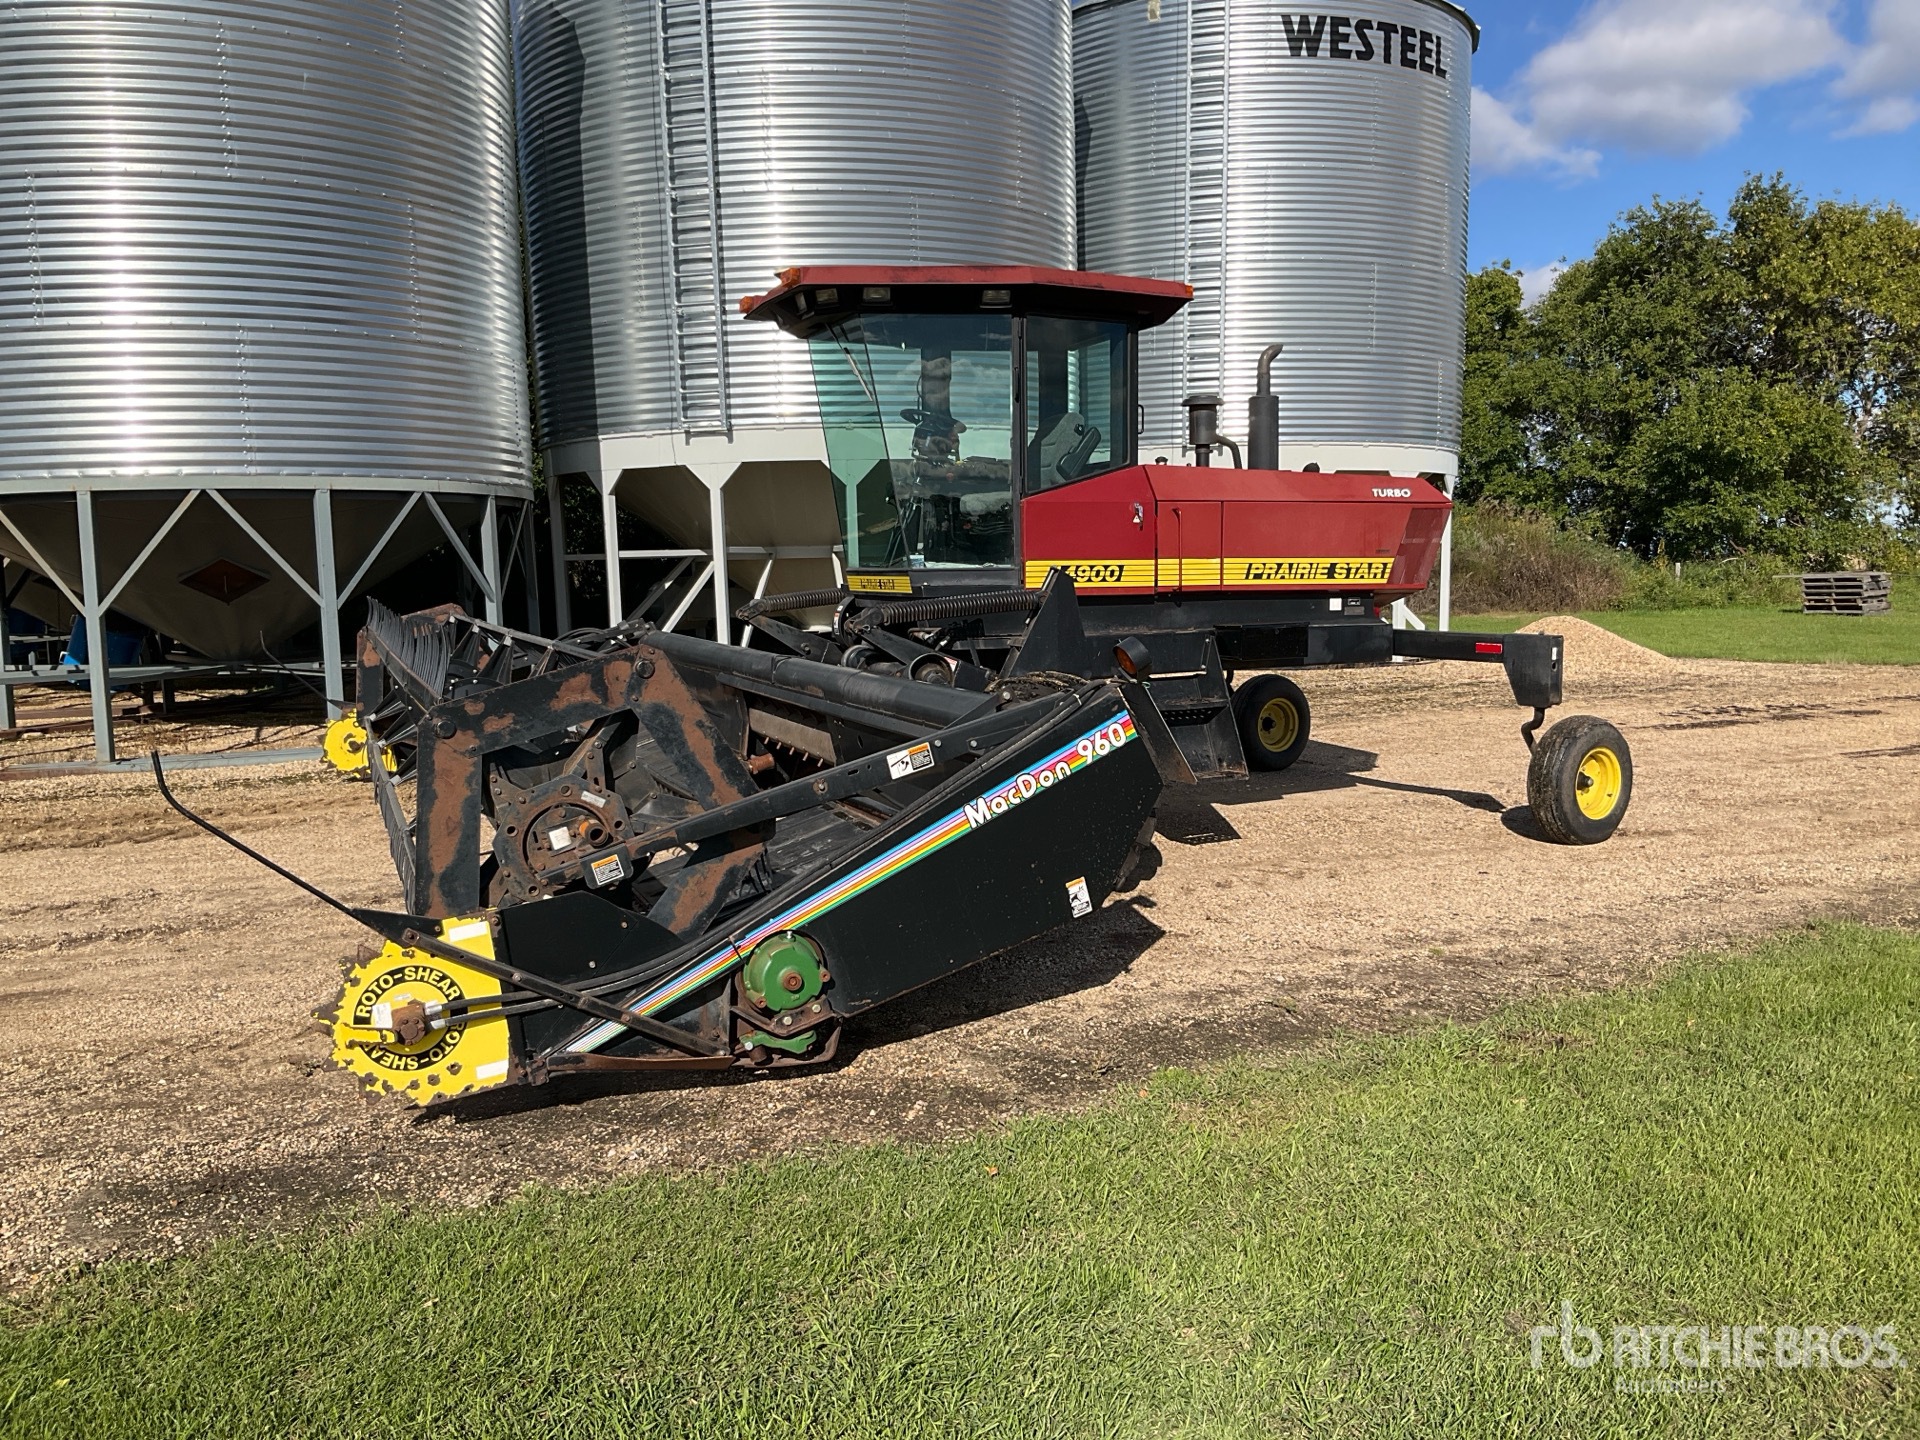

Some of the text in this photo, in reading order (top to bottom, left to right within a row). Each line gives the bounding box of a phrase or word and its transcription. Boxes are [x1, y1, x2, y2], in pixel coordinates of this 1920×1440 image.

[1281, 14, 1448, 80] WESTEEL
[1371, 488, 1411, 498] TURBO
[1248, 563, 1384, 580] PRAIRIE STAR
[963, 761, 1072, 829] MacDon
[1076, 721, 1127, 765] 960
[356, 967, 461, 1018] ROTO-SHEAR
